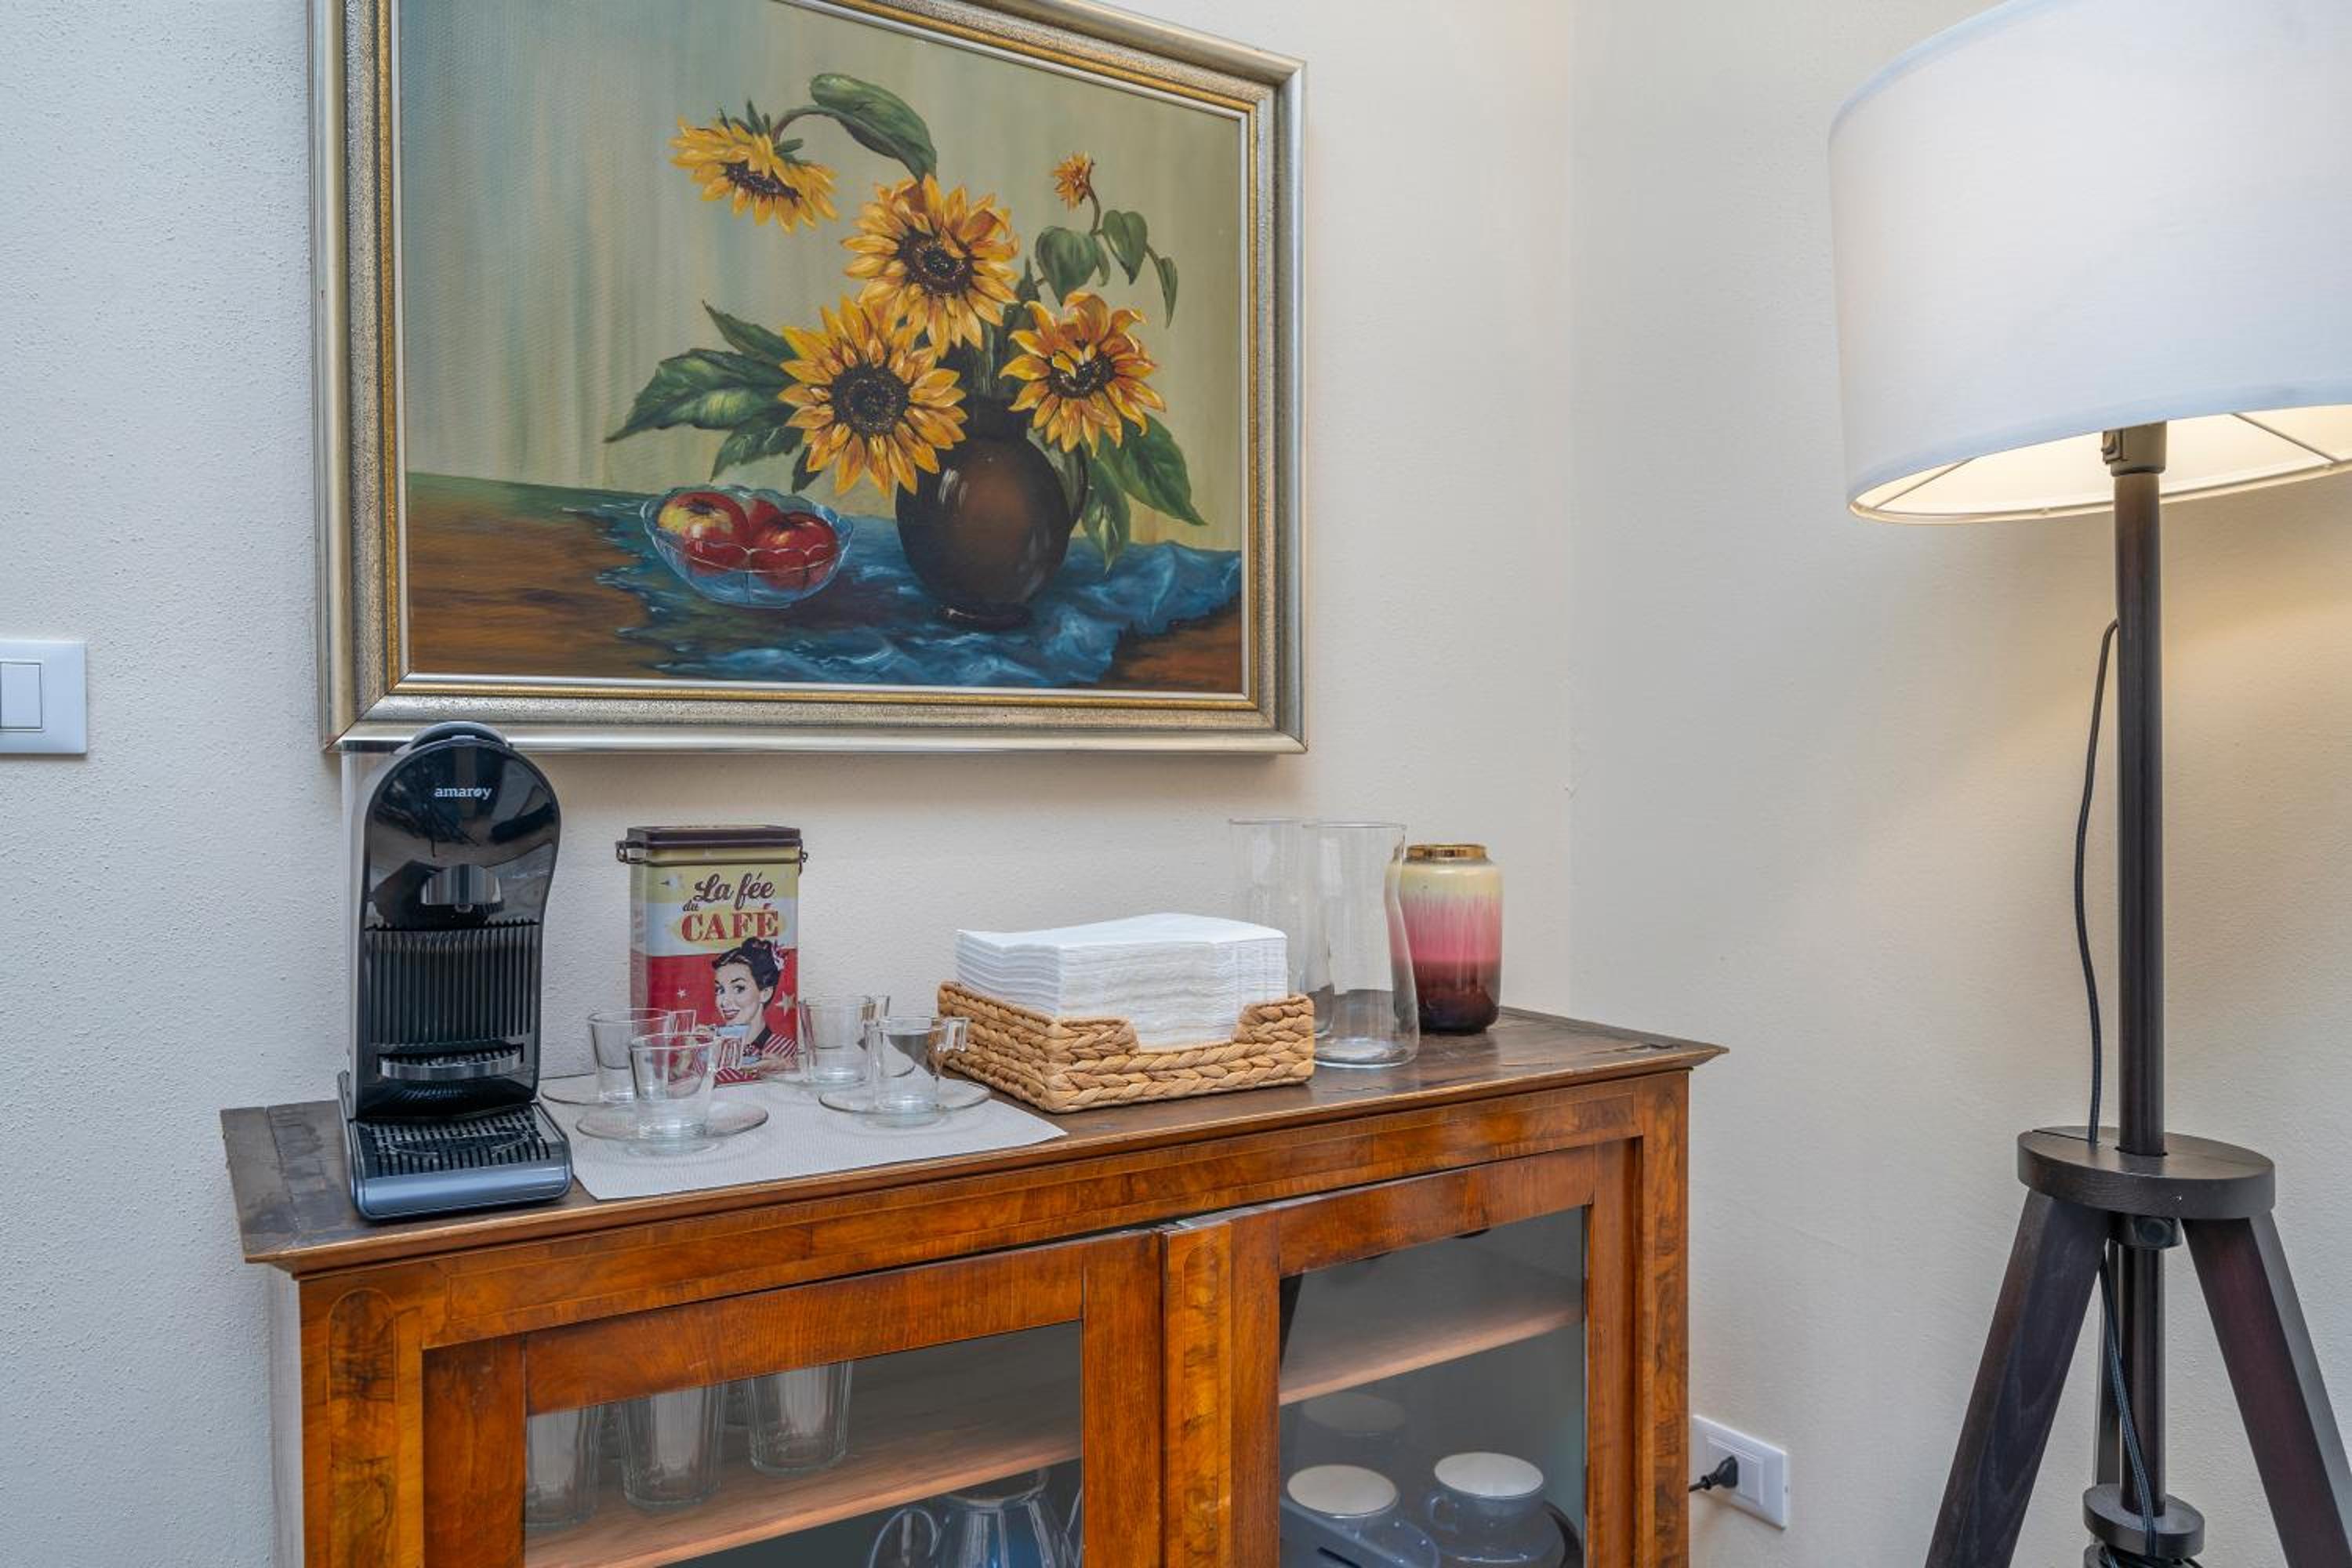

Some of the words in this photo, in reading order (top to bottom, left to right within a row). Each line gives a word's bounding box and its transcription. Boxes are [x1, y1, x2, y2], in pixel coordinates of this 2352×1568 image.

[682, 898, 699, 912] du
[693, 873, 734, 903] La
[734, 871, 775, 911] fée
[681, 902, 779, 942] CAFÉ
